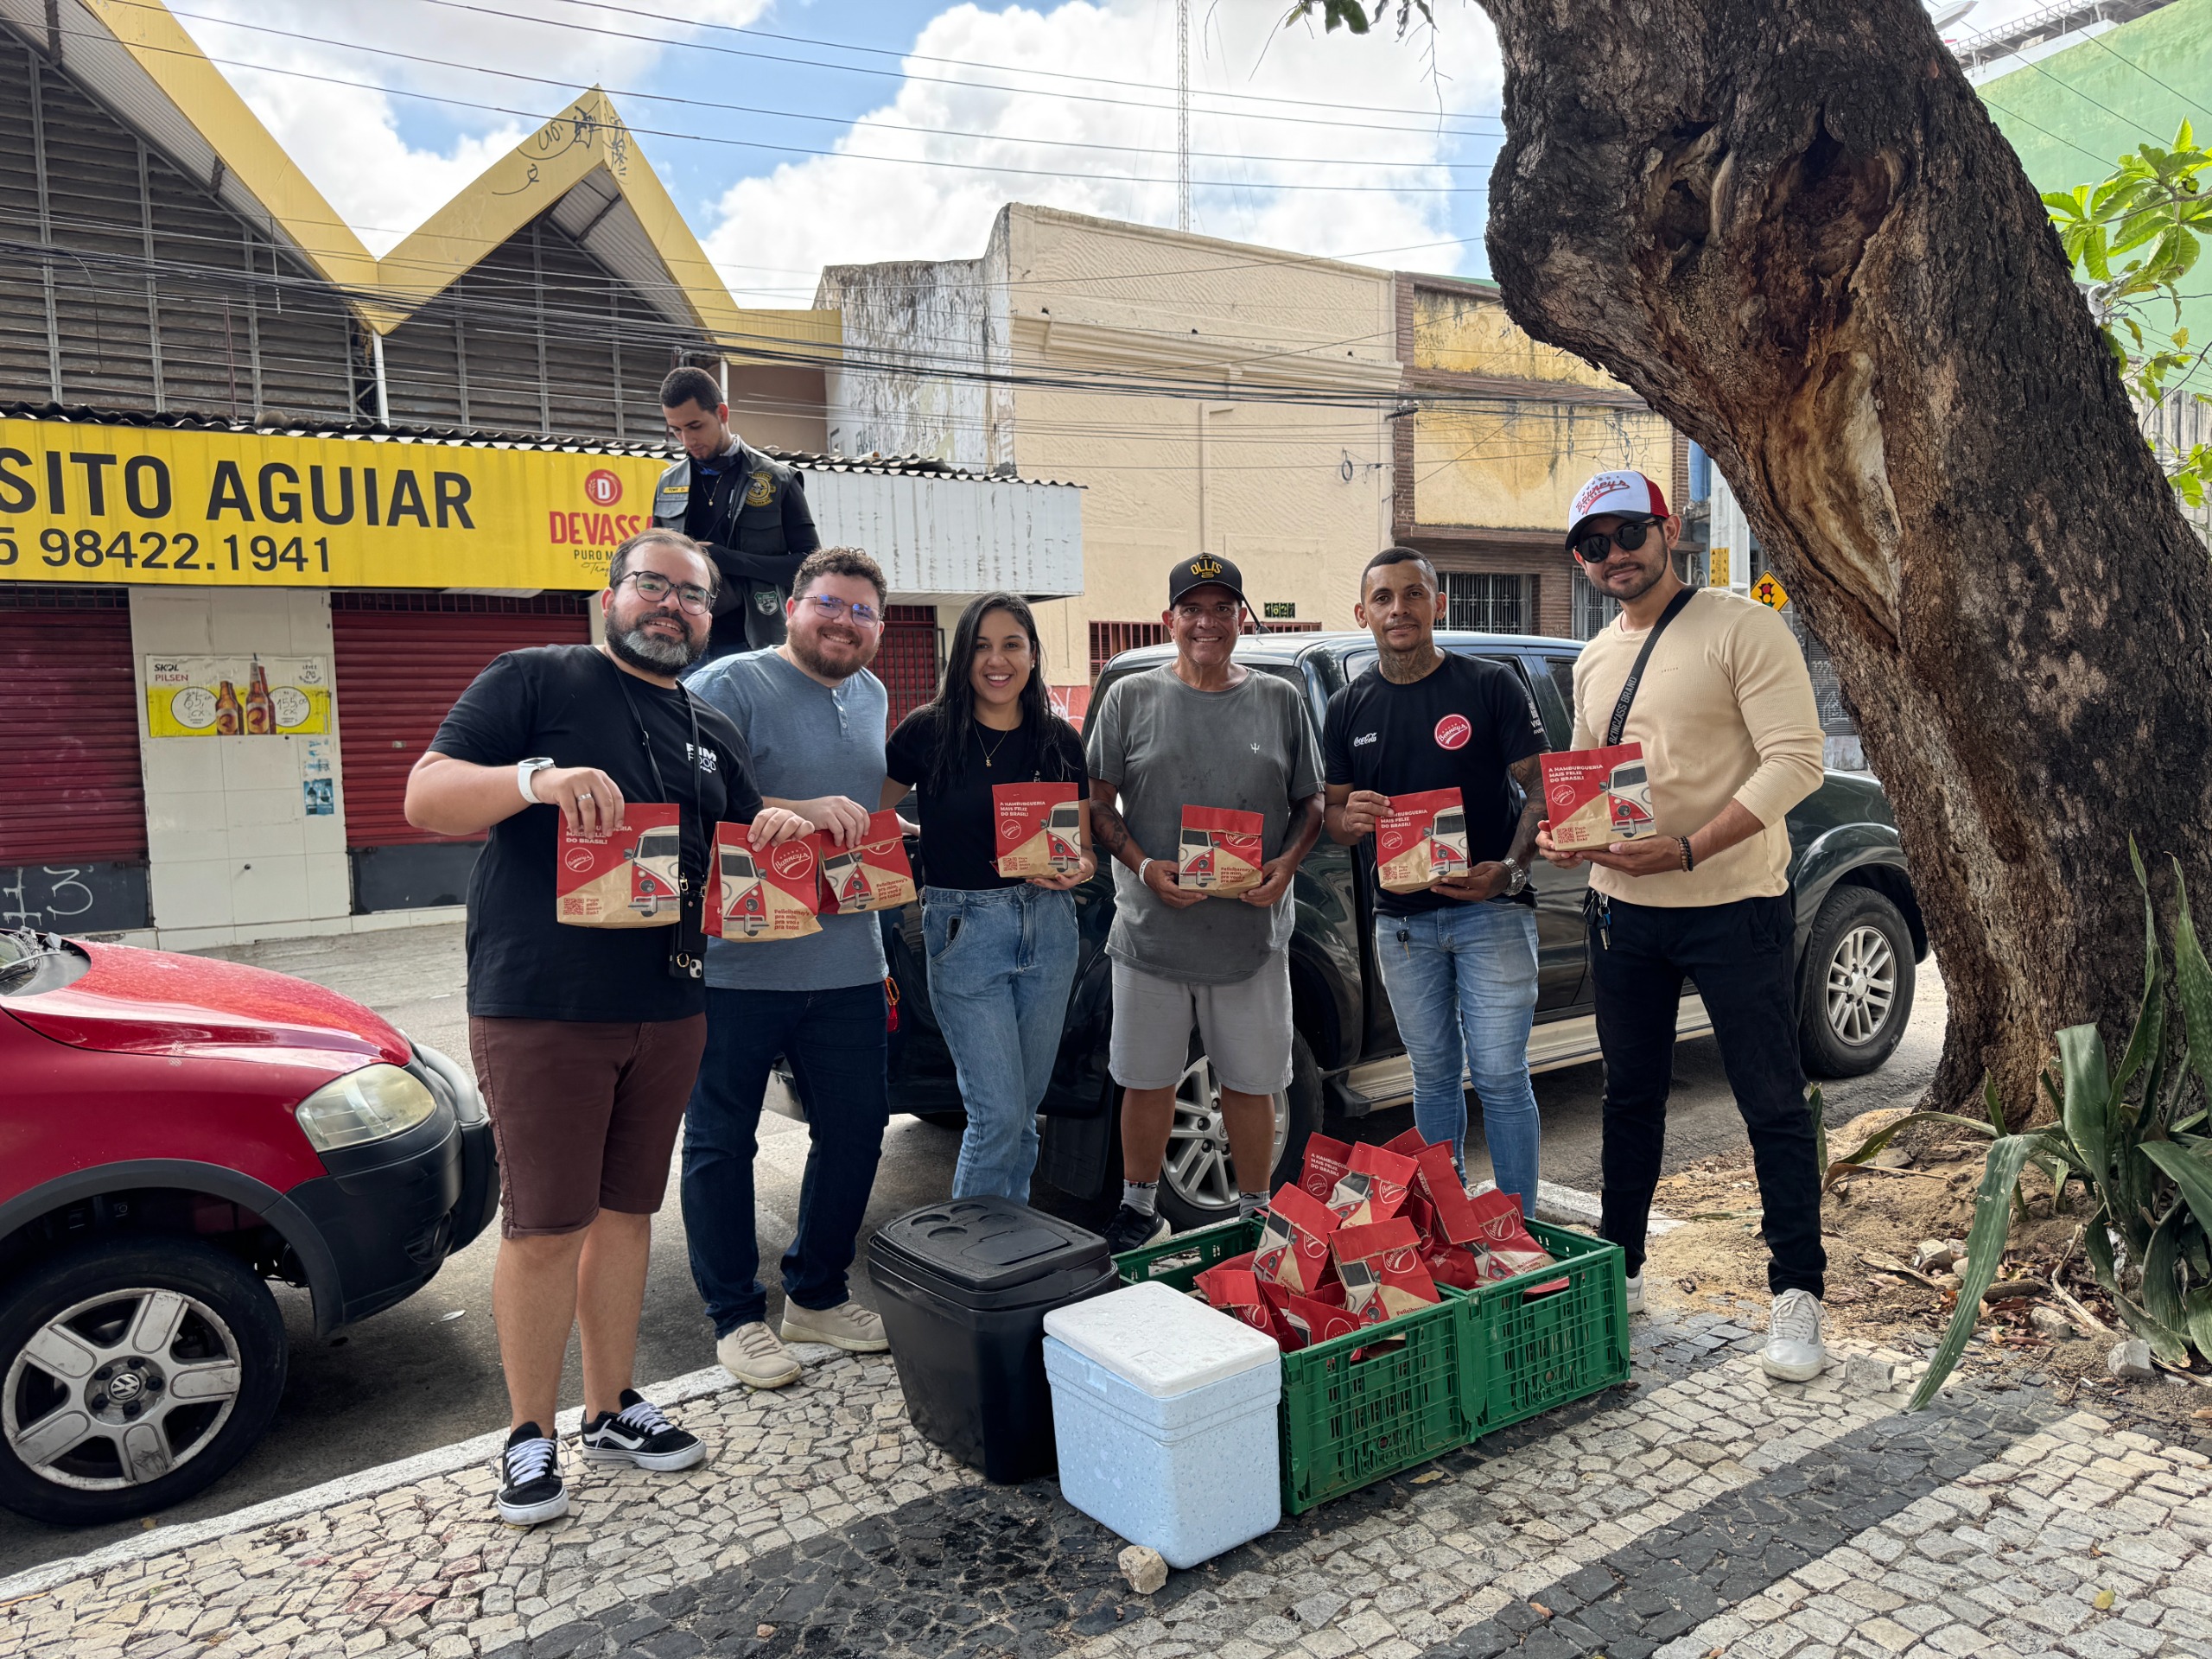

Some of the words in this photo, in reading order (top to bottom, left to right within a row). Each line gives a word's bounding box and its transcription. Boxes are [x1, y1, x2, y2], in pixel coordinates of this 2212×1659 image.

[206, 460, 475, 530] AGUIAR
[40, 528, 330, 573] 98422.1941
[574, 550, 602, 561] PURO
[1620, 676, 1637, 703] BRAND
[1311, 1158, 1324, 1166] MAIS
